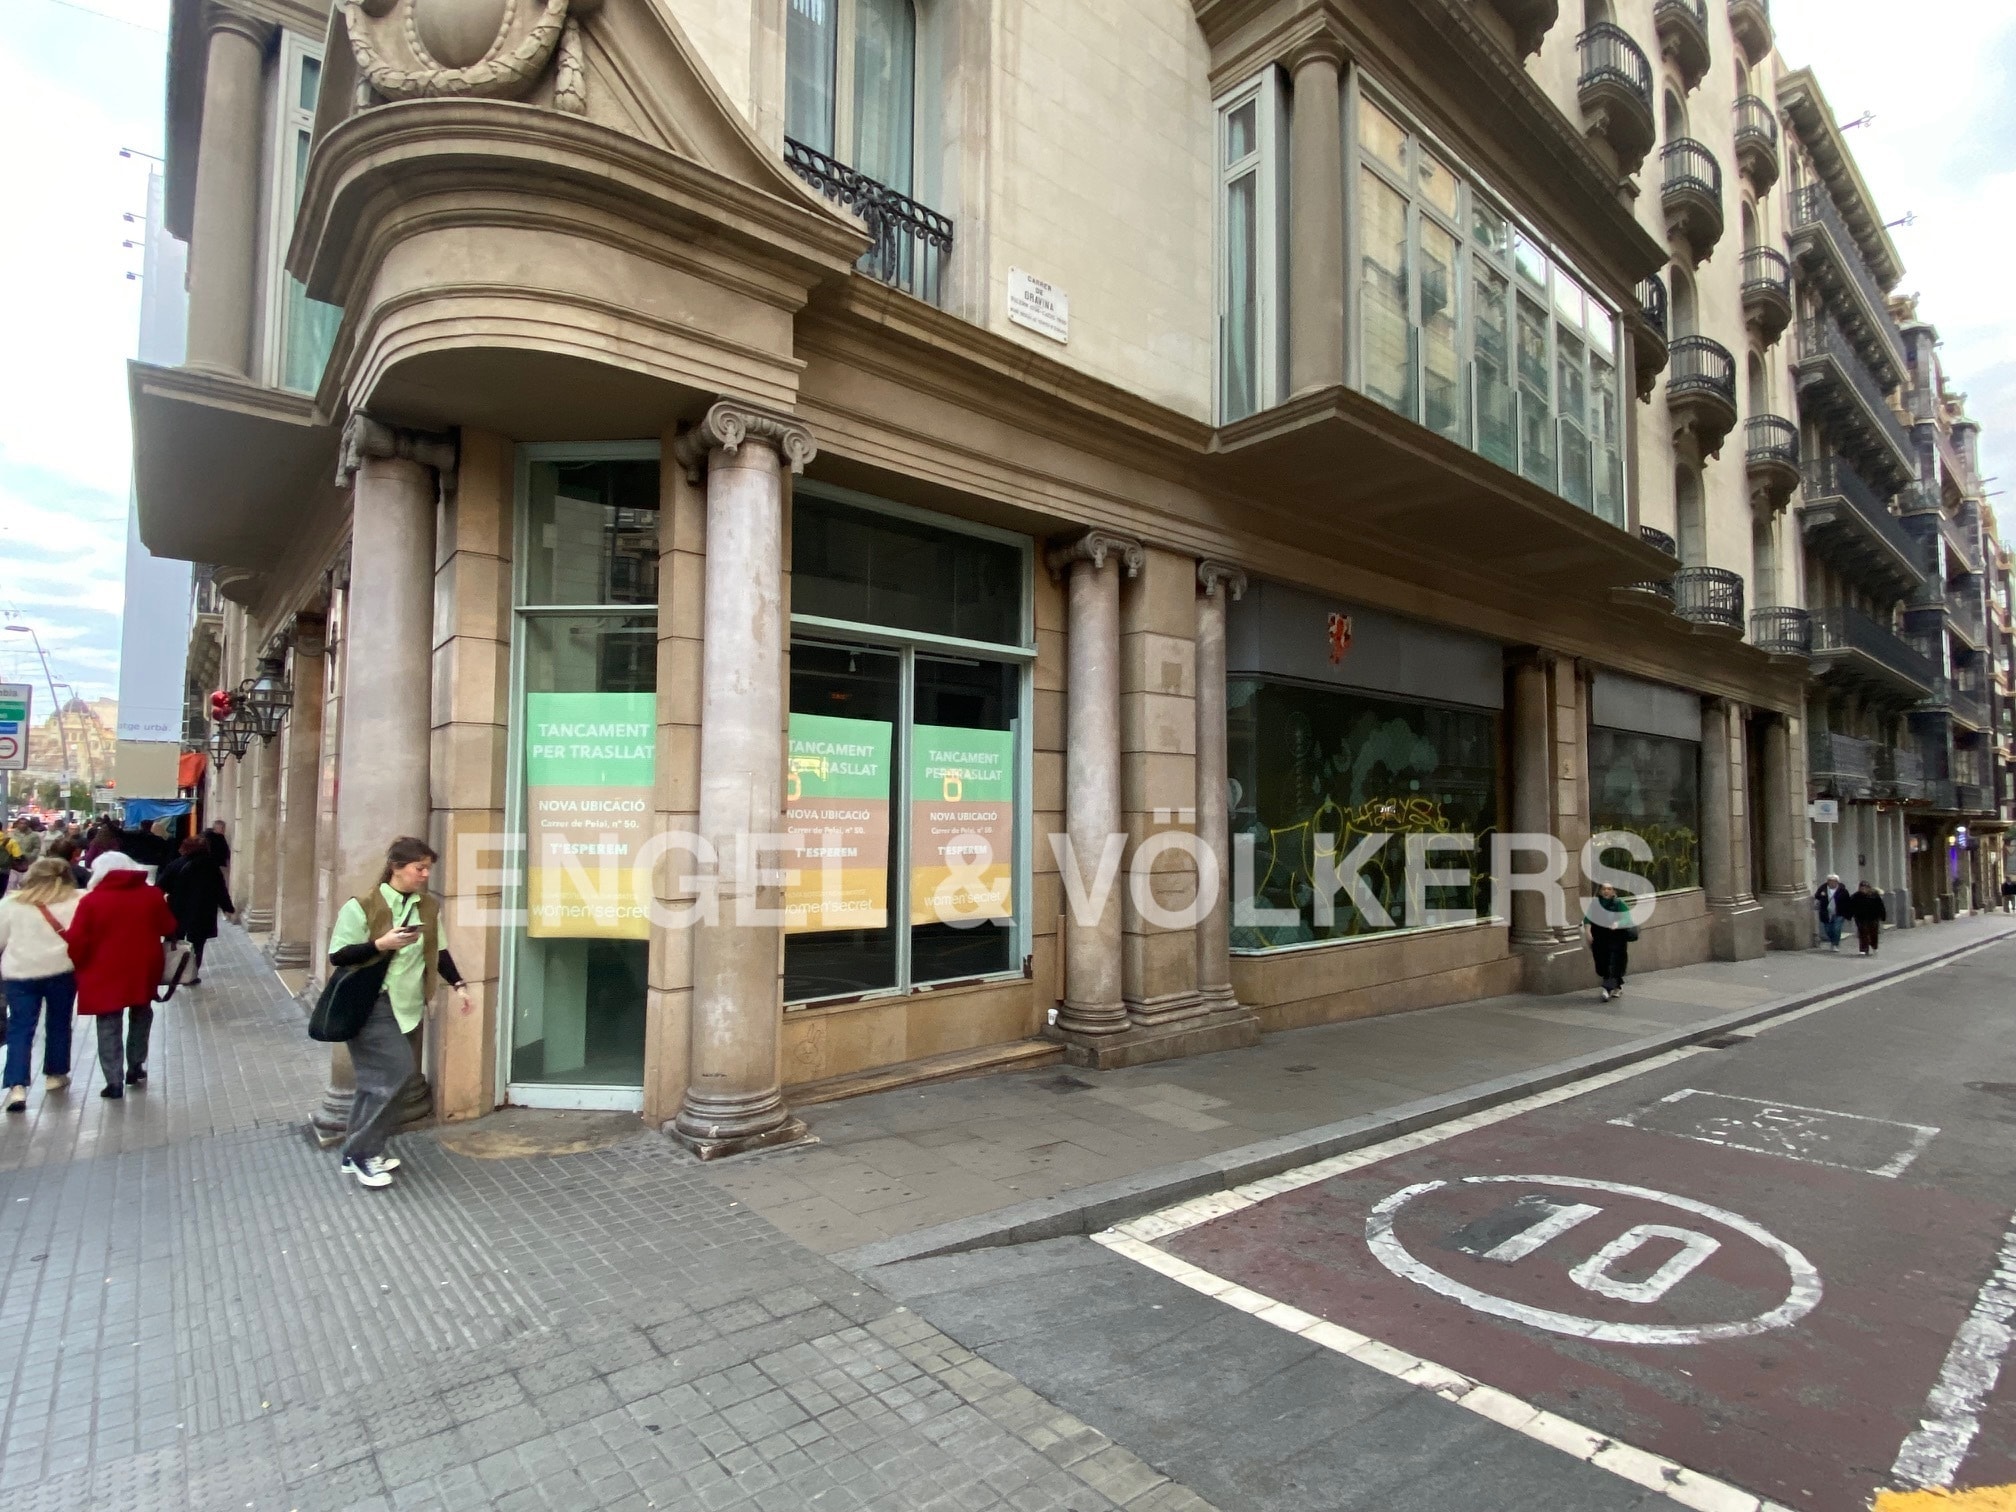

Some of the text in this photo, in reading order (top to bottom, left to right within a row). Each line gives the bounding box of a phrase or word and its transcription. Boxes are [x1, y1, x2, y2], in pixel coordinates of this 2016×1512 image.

[1035, 287, 1044, 296] DE
[1024, 290, 1055, 311] GRAVINA
[538, 723, 651, 738] TANCAMENT
[532, 744, 655, 759] PER TRASLLAT
[789, 740, 875, 758] TANCAMENT
[928, 750, 1000, 765] TANCAMENT
[538, 799, 646, 812] NOVA UBICACIÓ
[786, 808, 871, 821] NOVA UBICACIÓ
[930, 811, 998, 822] NOVA UBICACIÓ
[540, 819, 568, 829] Carrer
[571, 819, 583, 828] de
[624, 819, 640, 829] 50.
[550, 842, 629, 855] T'ESPEREM
[795, 847, 858, 858] T'ESPEREM
